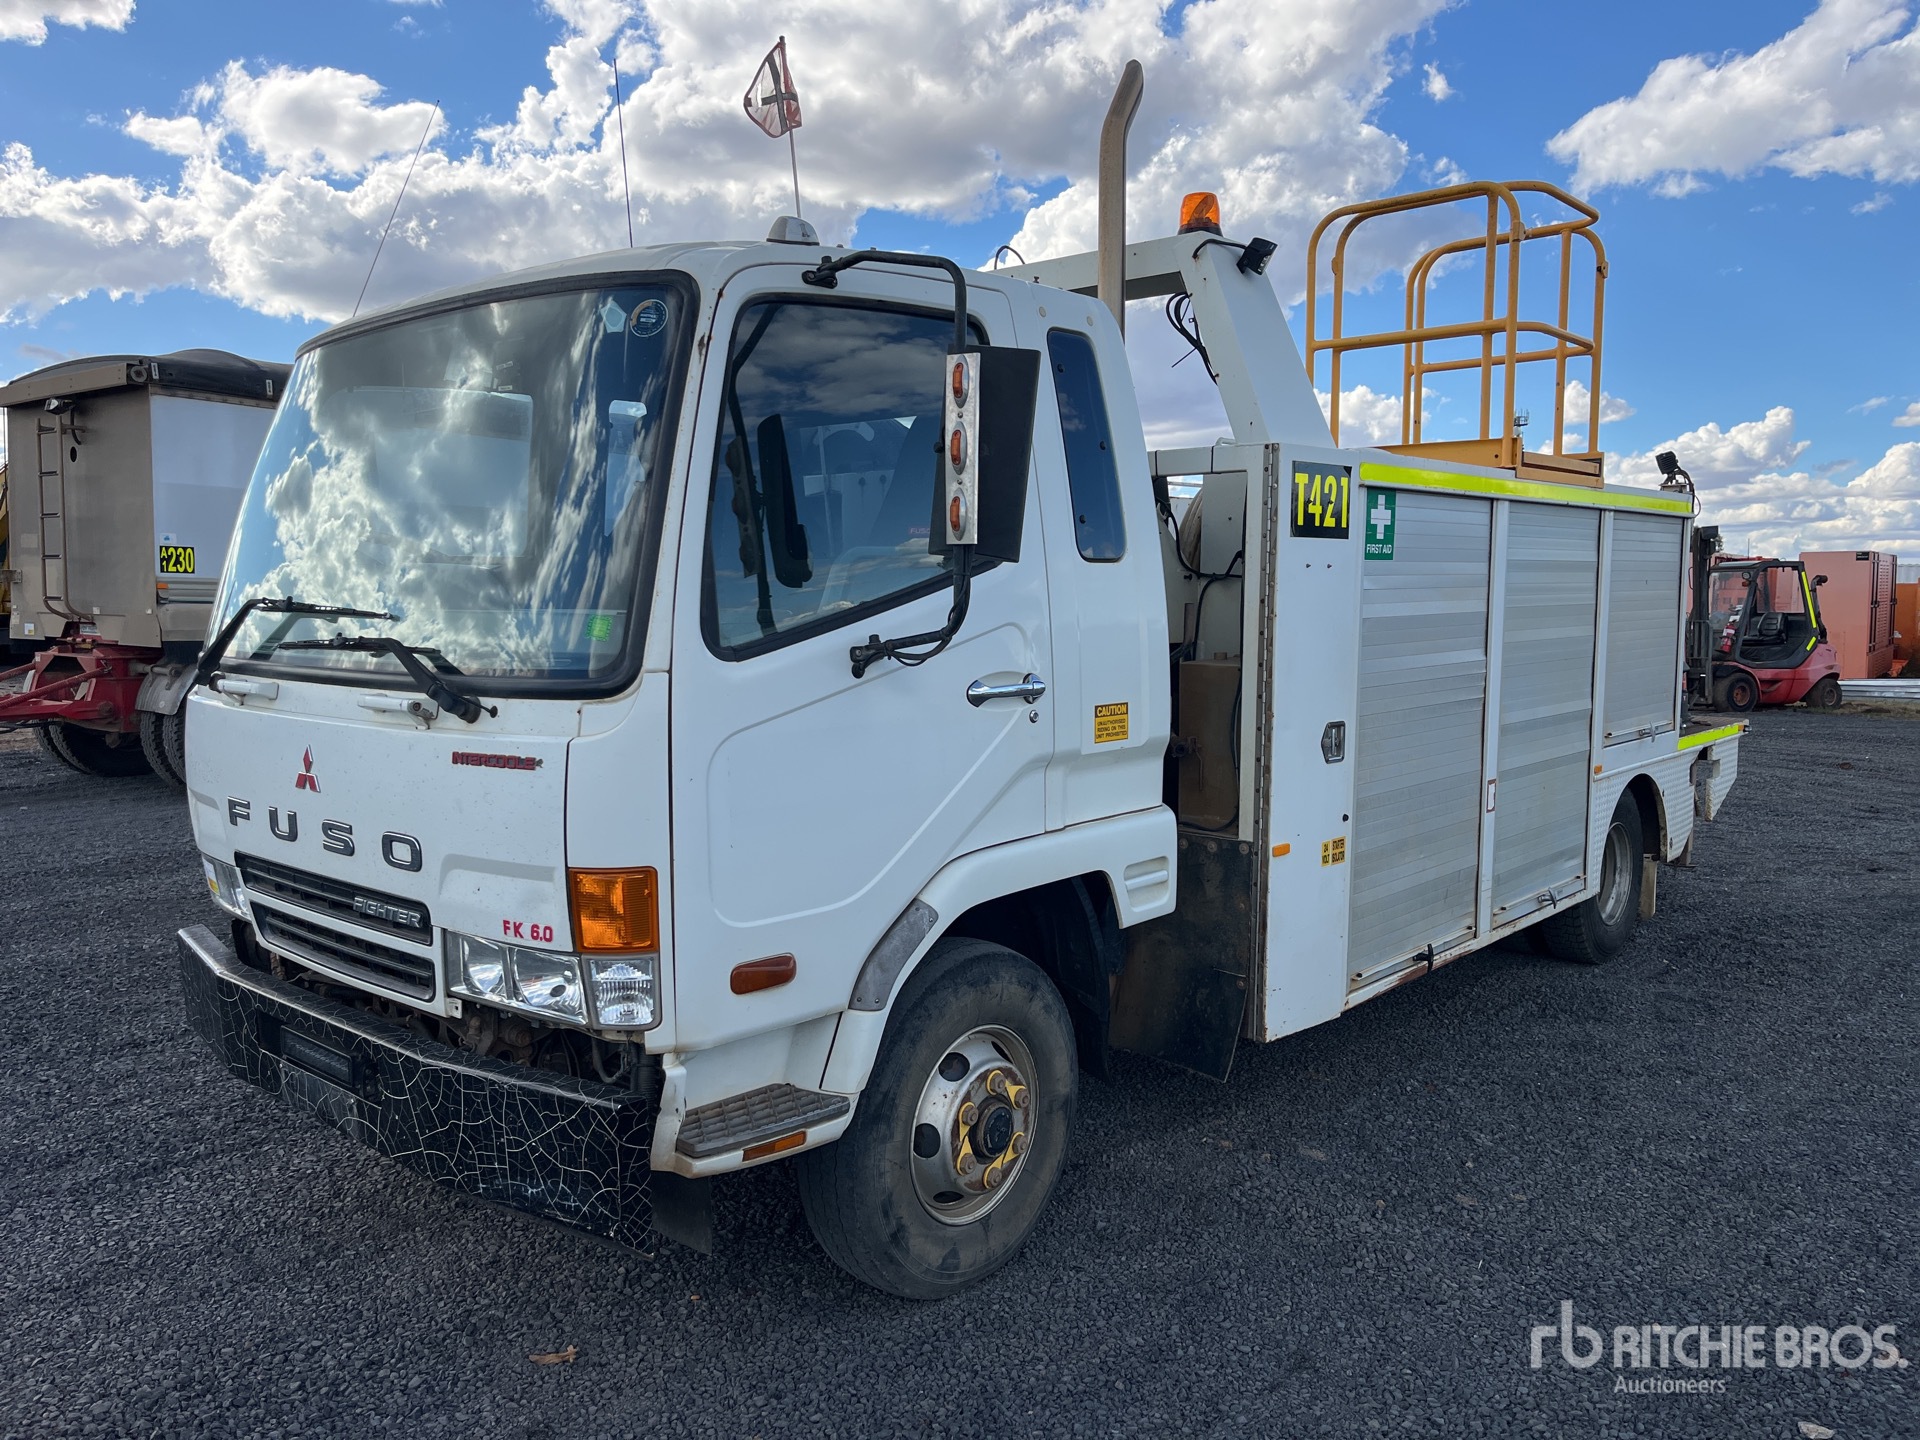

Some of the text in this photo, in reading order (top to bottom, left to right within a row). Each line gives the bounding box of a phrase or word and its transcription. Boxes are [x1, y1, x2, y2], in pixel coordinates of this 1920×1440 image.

[1295, 473, 1349, 528] T421
[168, 547, 194, 573] 230
[1366, 544, 1392, 554] FIRST AID
[1097, 704, 1126, 716] CAUTION
[228, 796, 423, 873] FUSO
[353, 896, 423, 928] FIGHTER
[503, 919, 554, 943] FK 6.0
